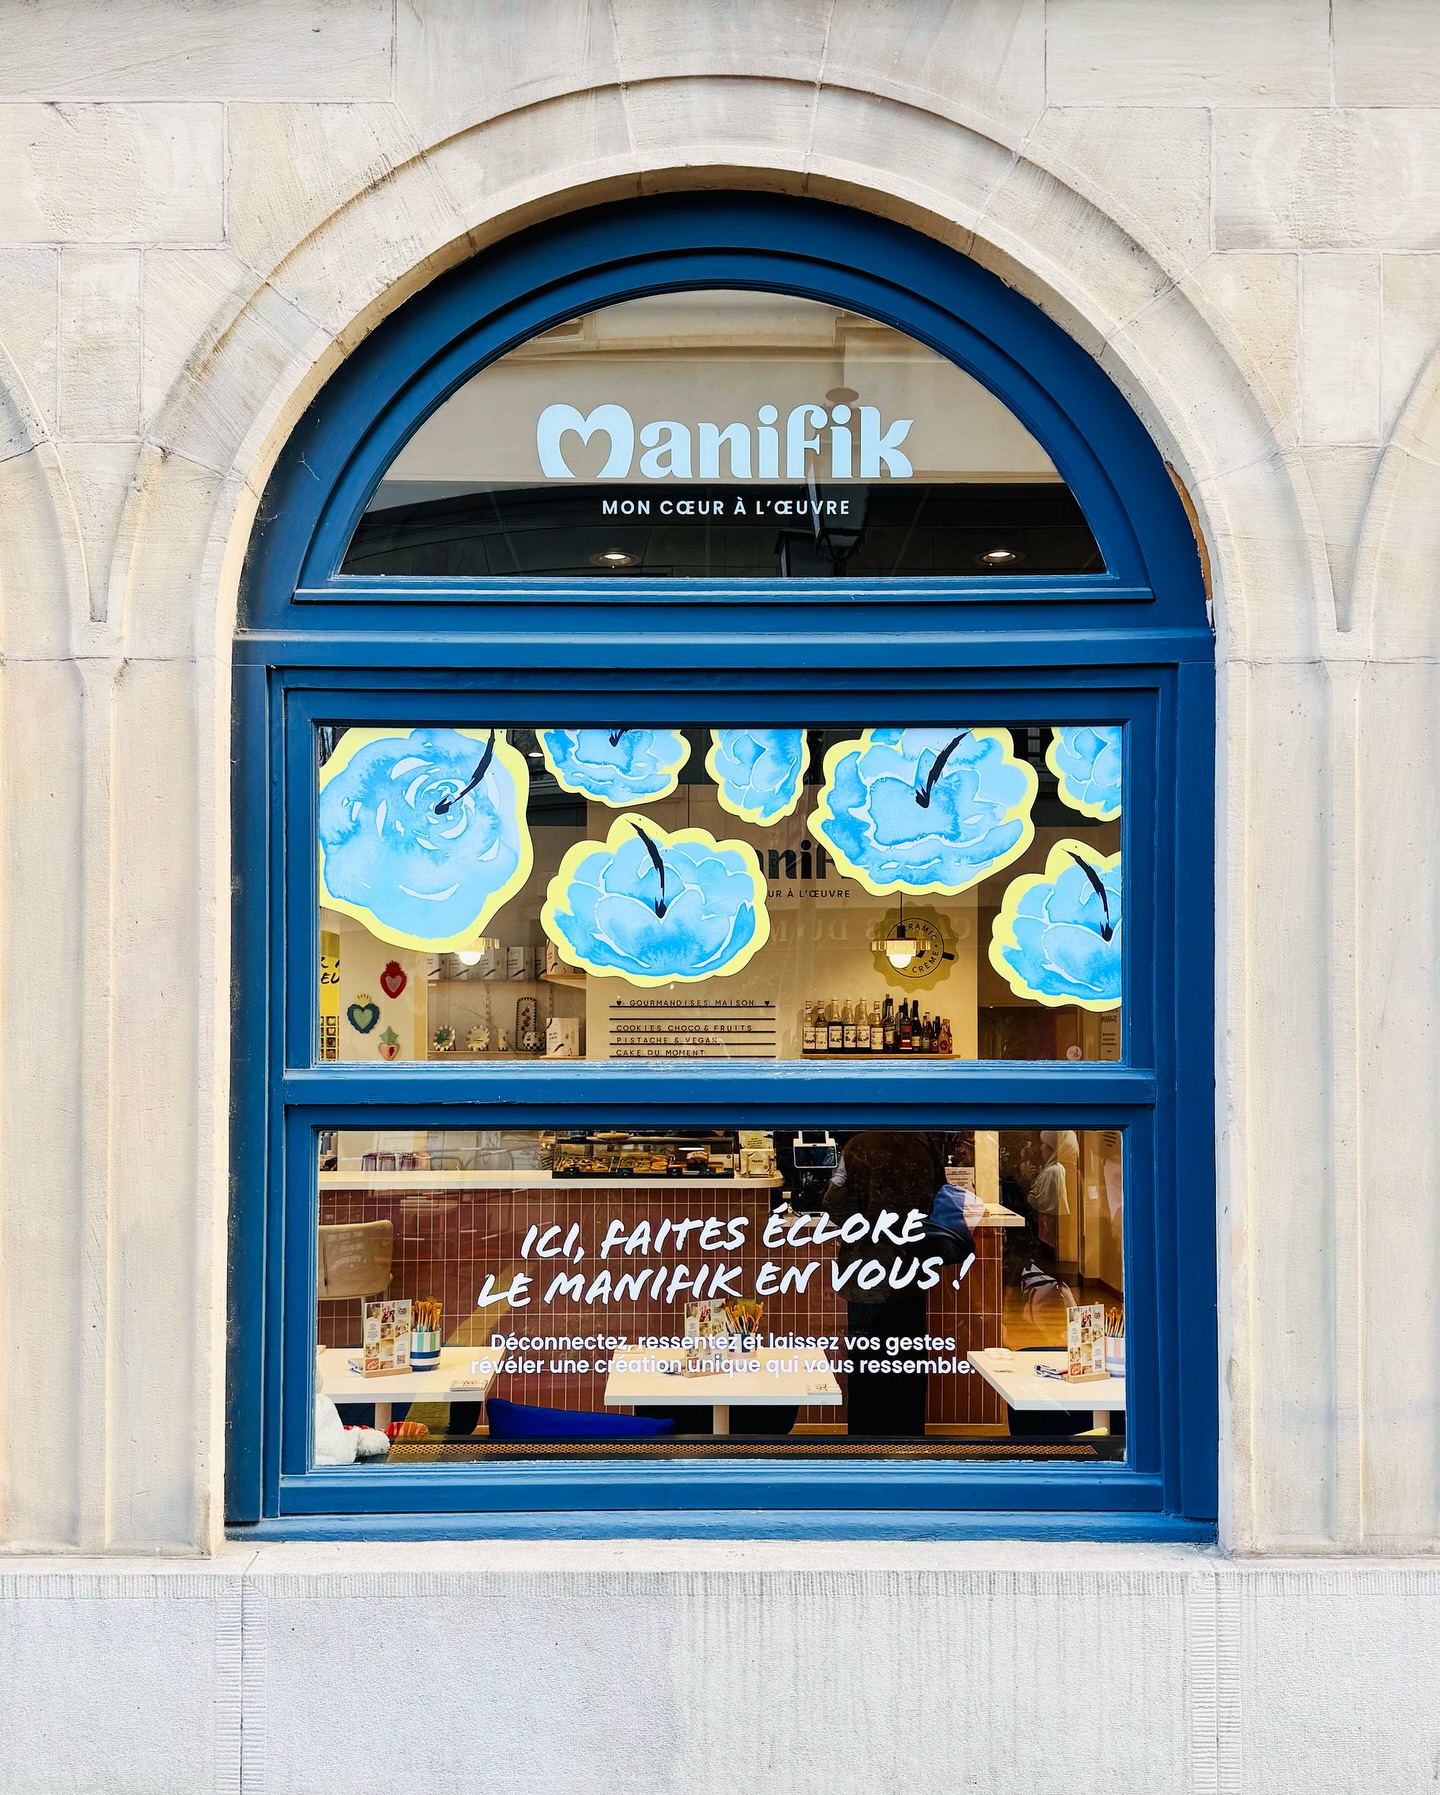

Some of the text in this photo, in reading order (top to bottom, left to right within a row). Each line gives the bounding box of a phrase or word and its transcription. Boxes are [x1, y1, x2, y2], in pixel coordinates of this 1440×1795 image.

[536, 404, 913, 478] Manifik
[602, 497, 850, 515] MON CŒUR À L’ŒUVRE
[787, 887, 794, 898] À
[906, 923, 938, 941] RAMIC
[629, 999, 755, 1007] GOURMANDISES MAISON
[616, 1024, 753, 1032] COOKIES CHOCO & FRUITS
[616, 1049, 705, 1057] CAKE DU MOMENT
[520, 1202, 927, 1264] ICI, FAITES ÉCLORE
[477, 1252, 976, 1308] LE MANIFIK EN VOUS !
[491, 1332, 956, 1356] Déconnectez, ressentez et laissez vos gestes
[471, 1355, 976, 1378] révéler une création unique qui vous ressemble.
